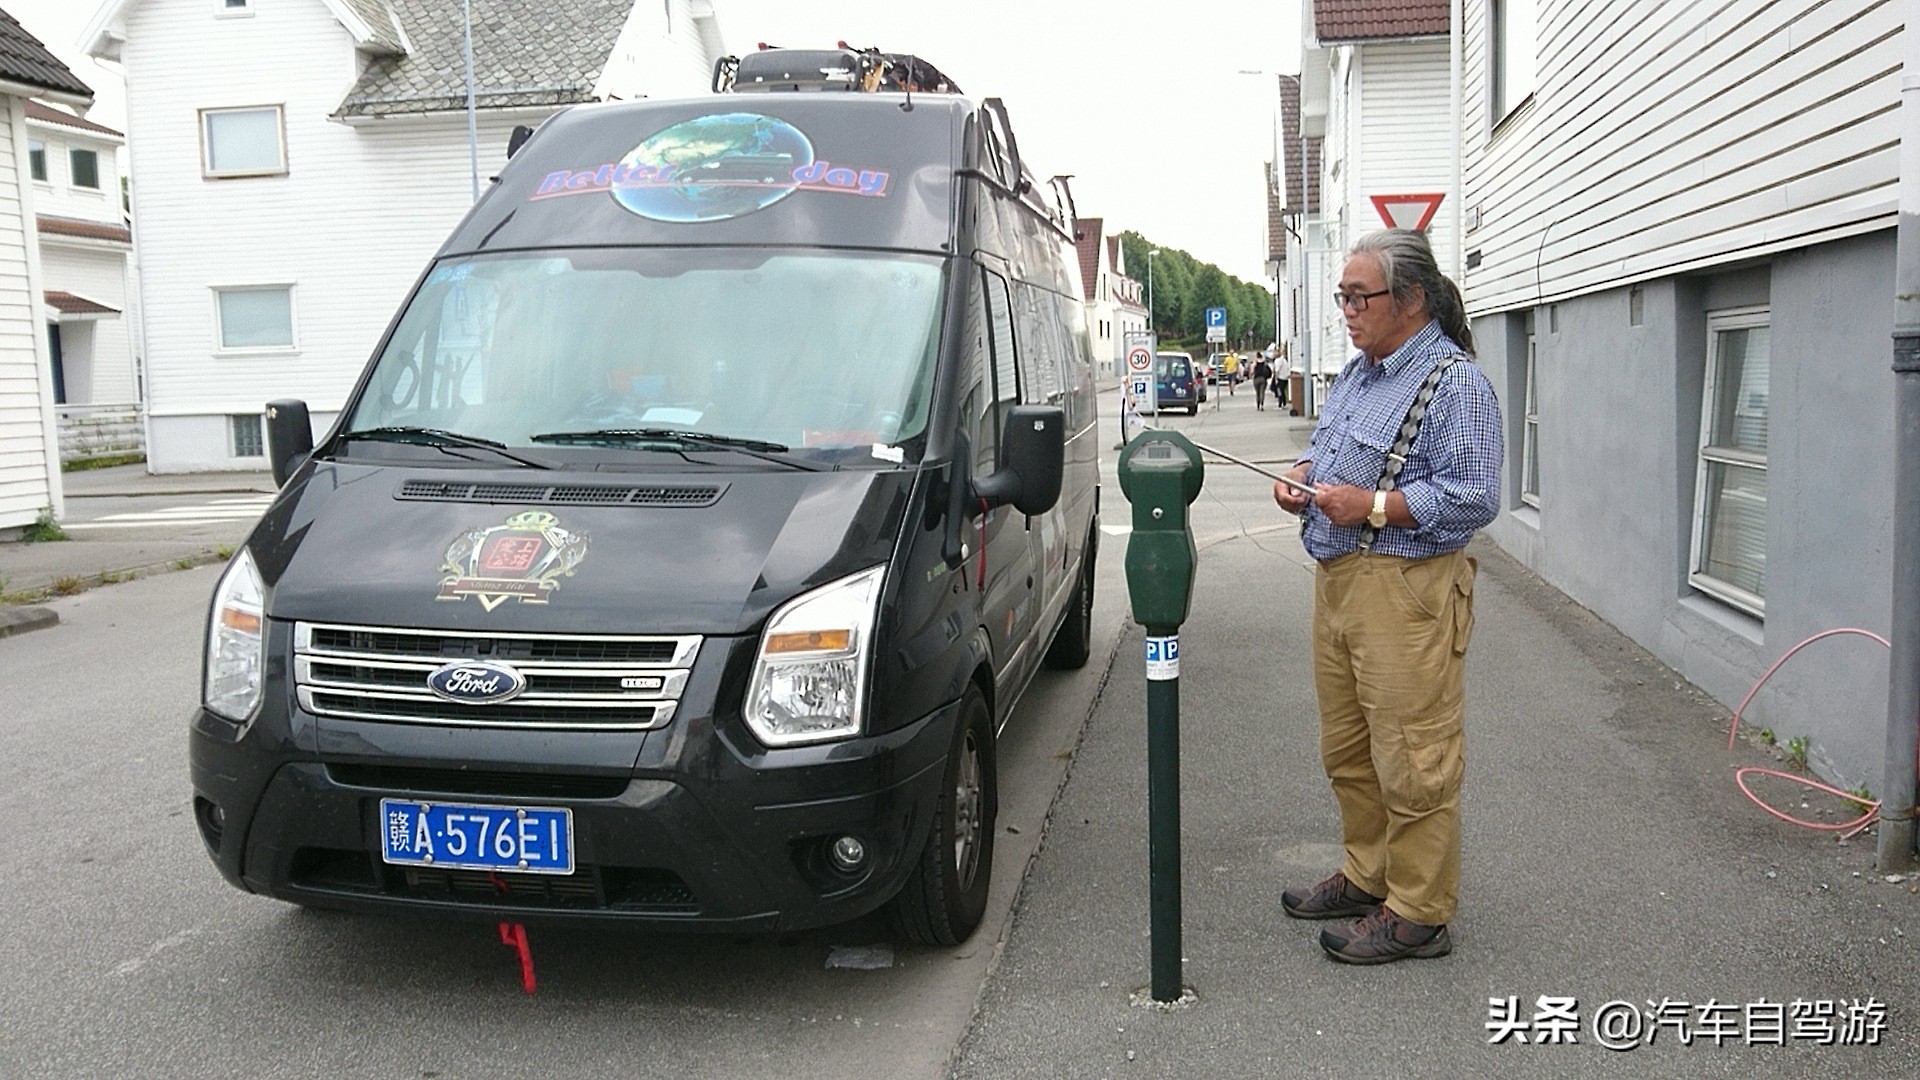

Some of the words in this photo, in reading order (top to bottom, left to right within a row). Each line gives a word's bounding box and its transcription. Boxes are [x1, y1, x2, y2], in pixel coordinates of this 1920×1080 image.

[535, 163, 678, 196] Better
[792, 161, 889, 196] day
[1211, 311, 1222, 326] P
[1133, 354, 1147, 365] 30
[1147, 643, 1157, 659] P
[1167, 641, 1178, 659] P
[446, 667, 500, 694] Ford
